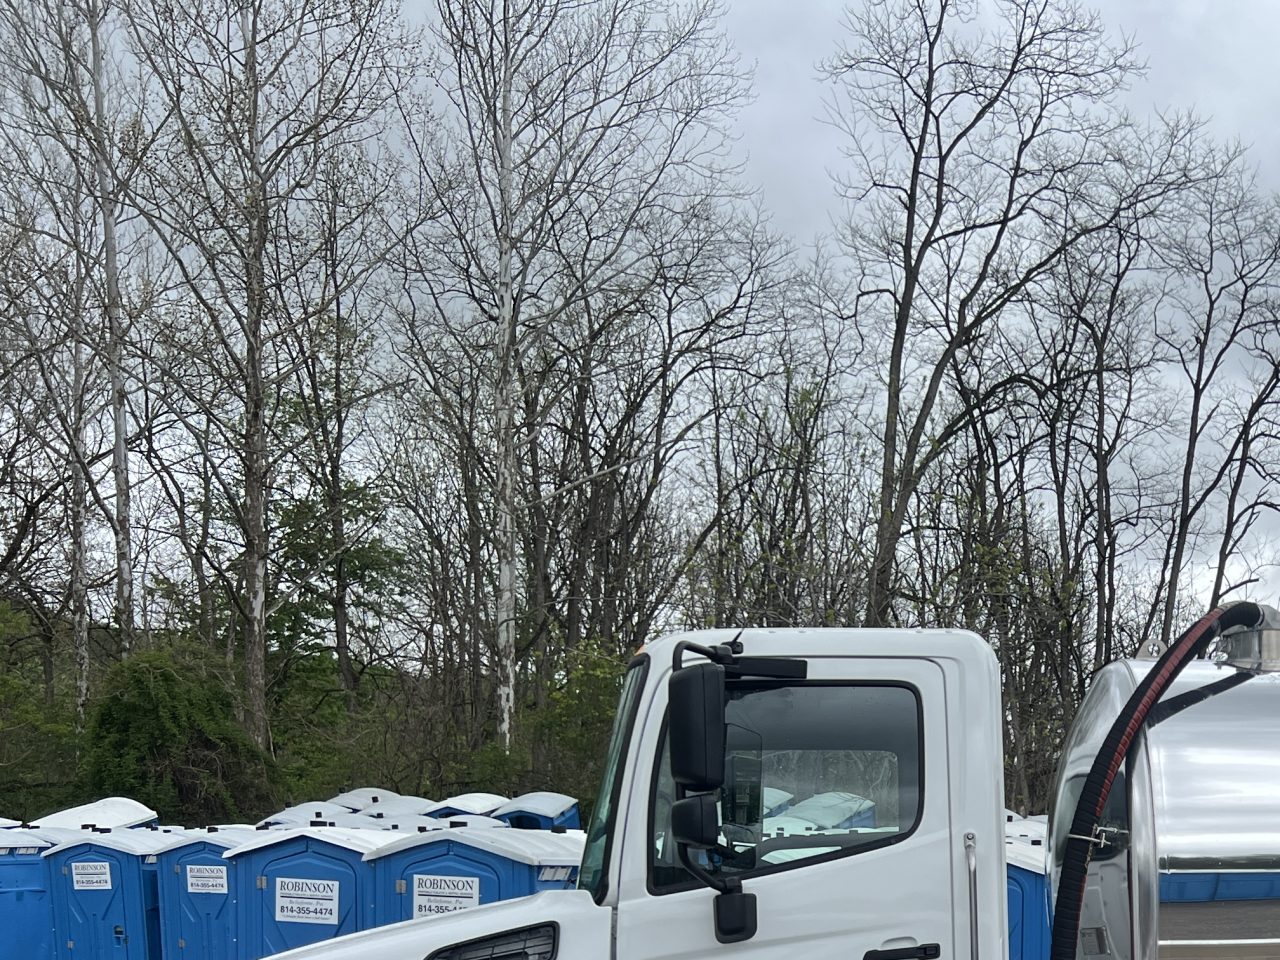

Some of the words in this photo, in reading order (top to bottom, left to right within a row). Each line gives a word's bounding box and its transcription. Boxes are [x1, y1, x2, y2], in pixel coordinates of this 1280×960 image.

[280, 880, 335, 893] ROBINSON
[417, 878, 474, 891] ROBINSON
[280, 905, 333, 916] 814-355-4474
